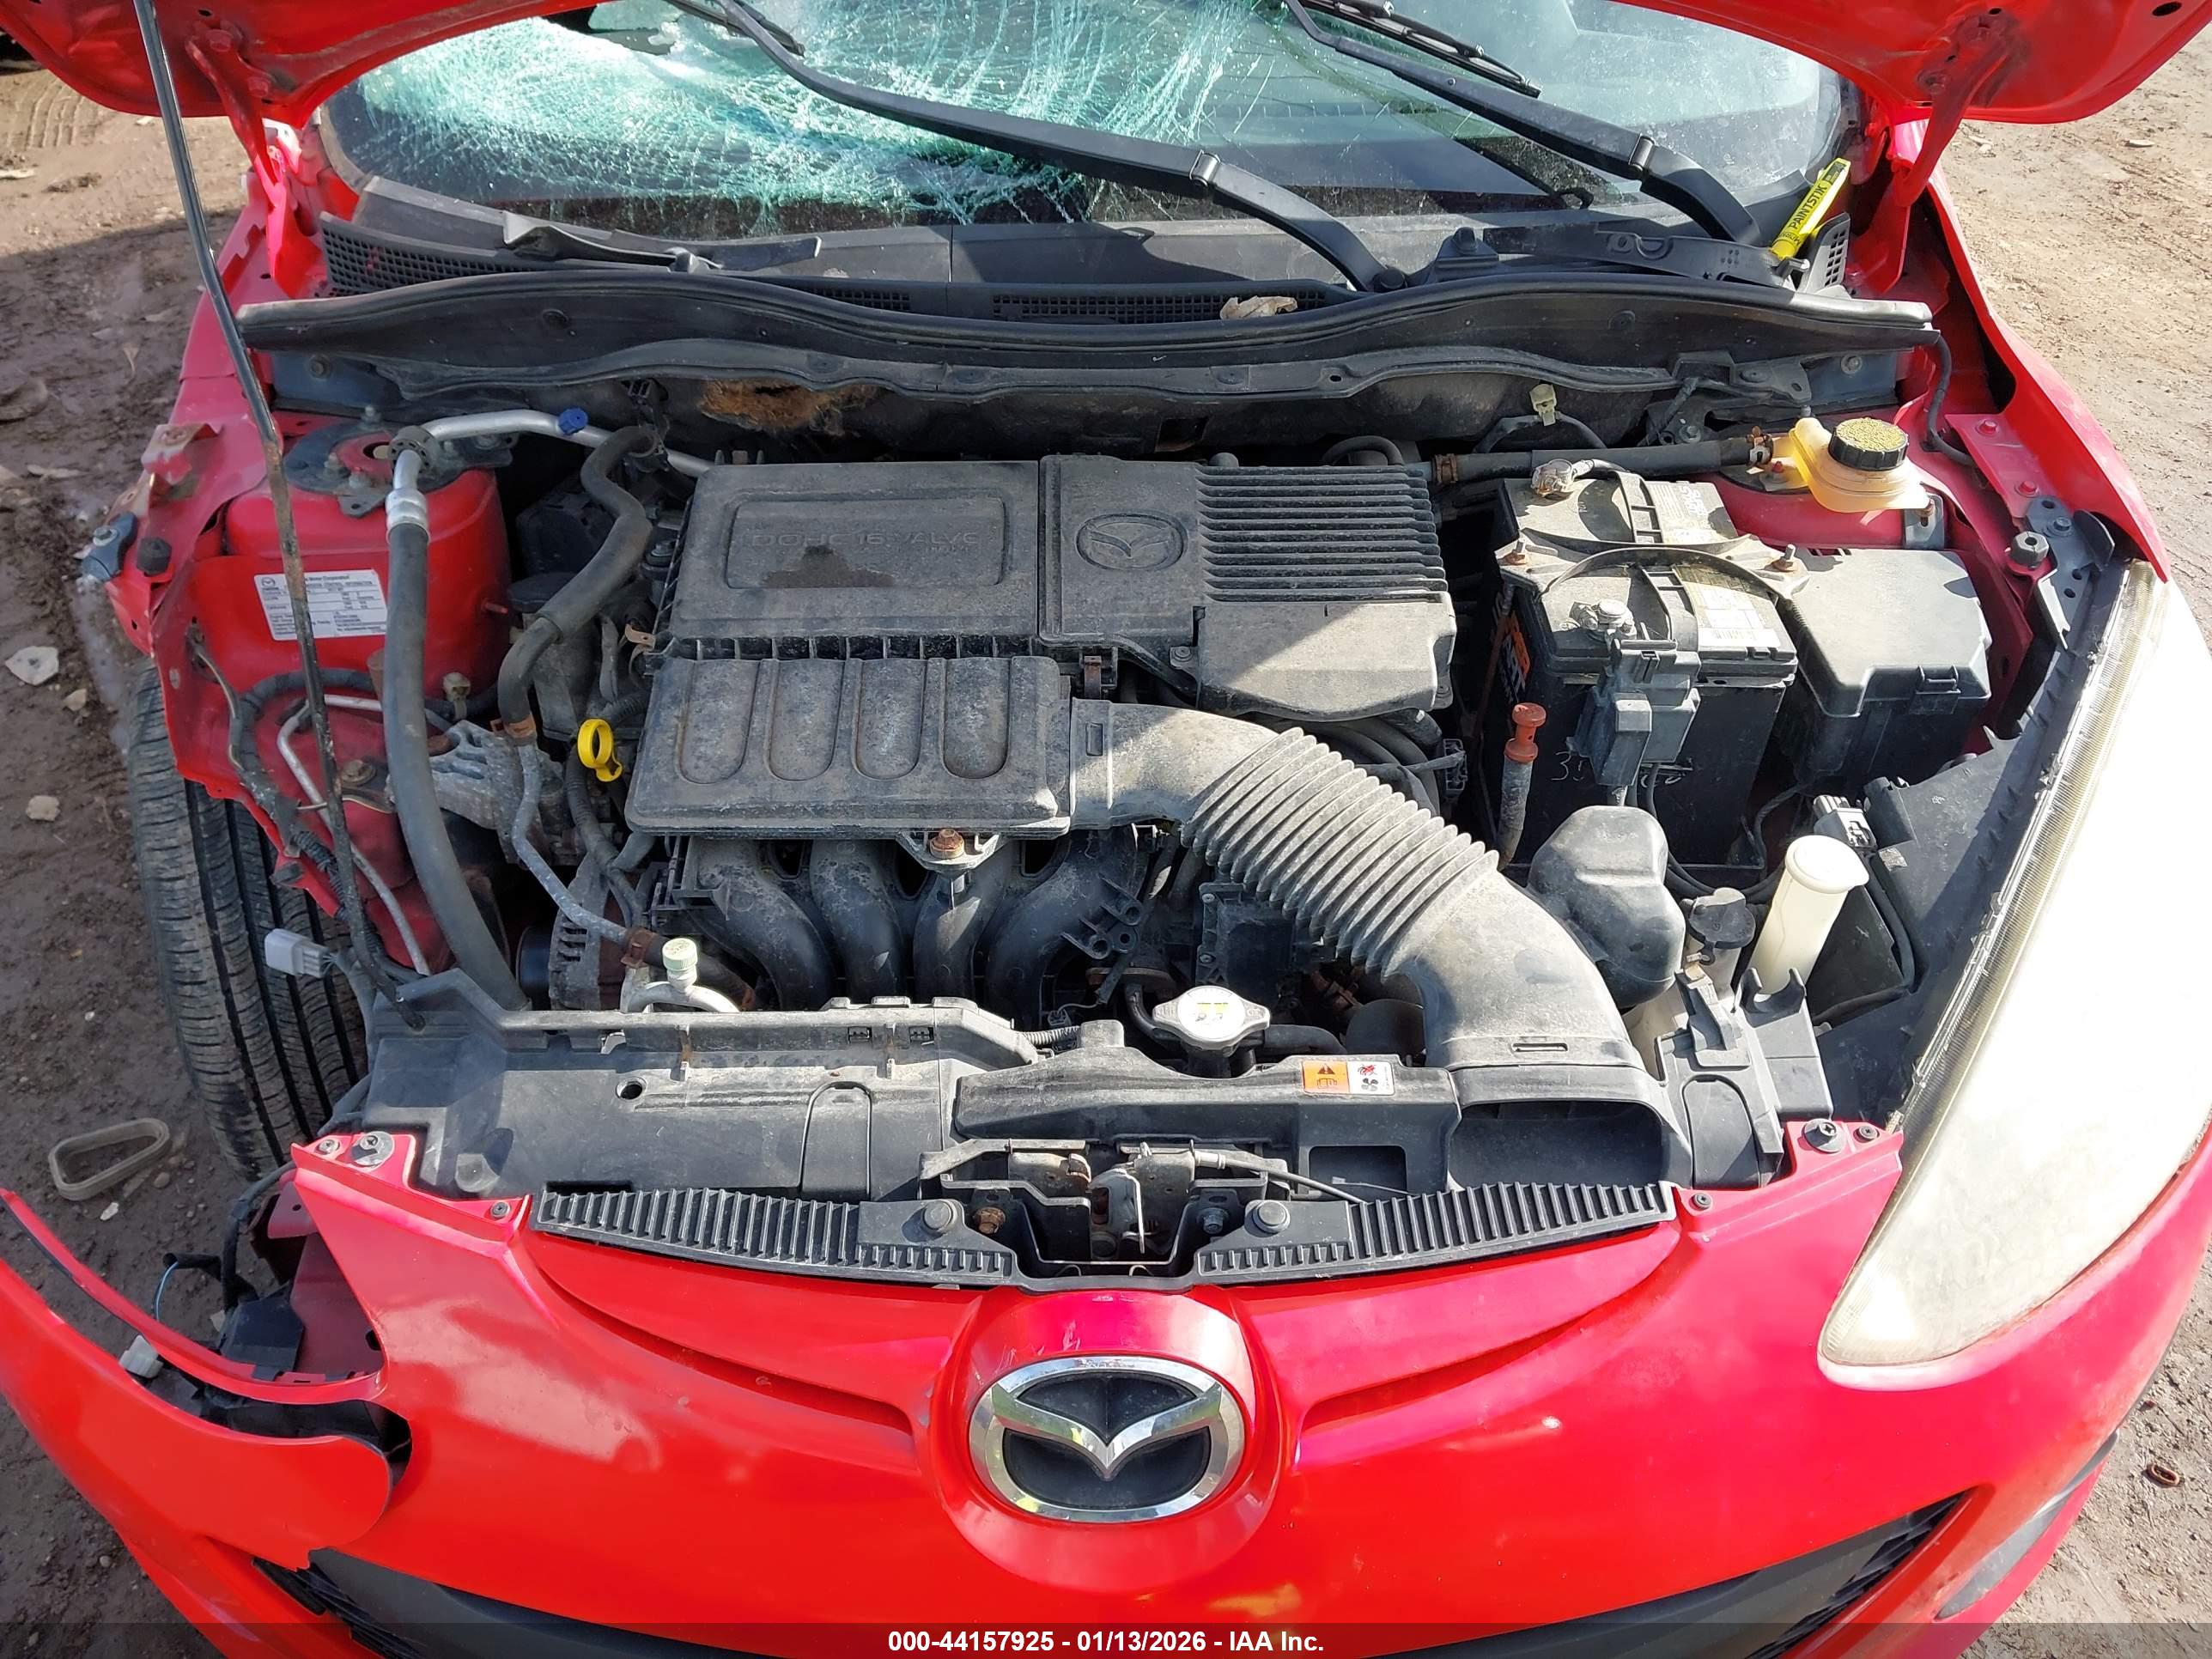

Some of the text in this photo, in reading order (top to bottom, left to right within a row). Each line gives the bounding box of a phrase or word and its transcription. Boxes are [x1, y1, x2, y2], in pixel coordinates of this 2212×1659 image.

[1788, 183, 1828, 230] PAINTSTIK
[751, 532, 979, 547] DOHC 16 VALVE
